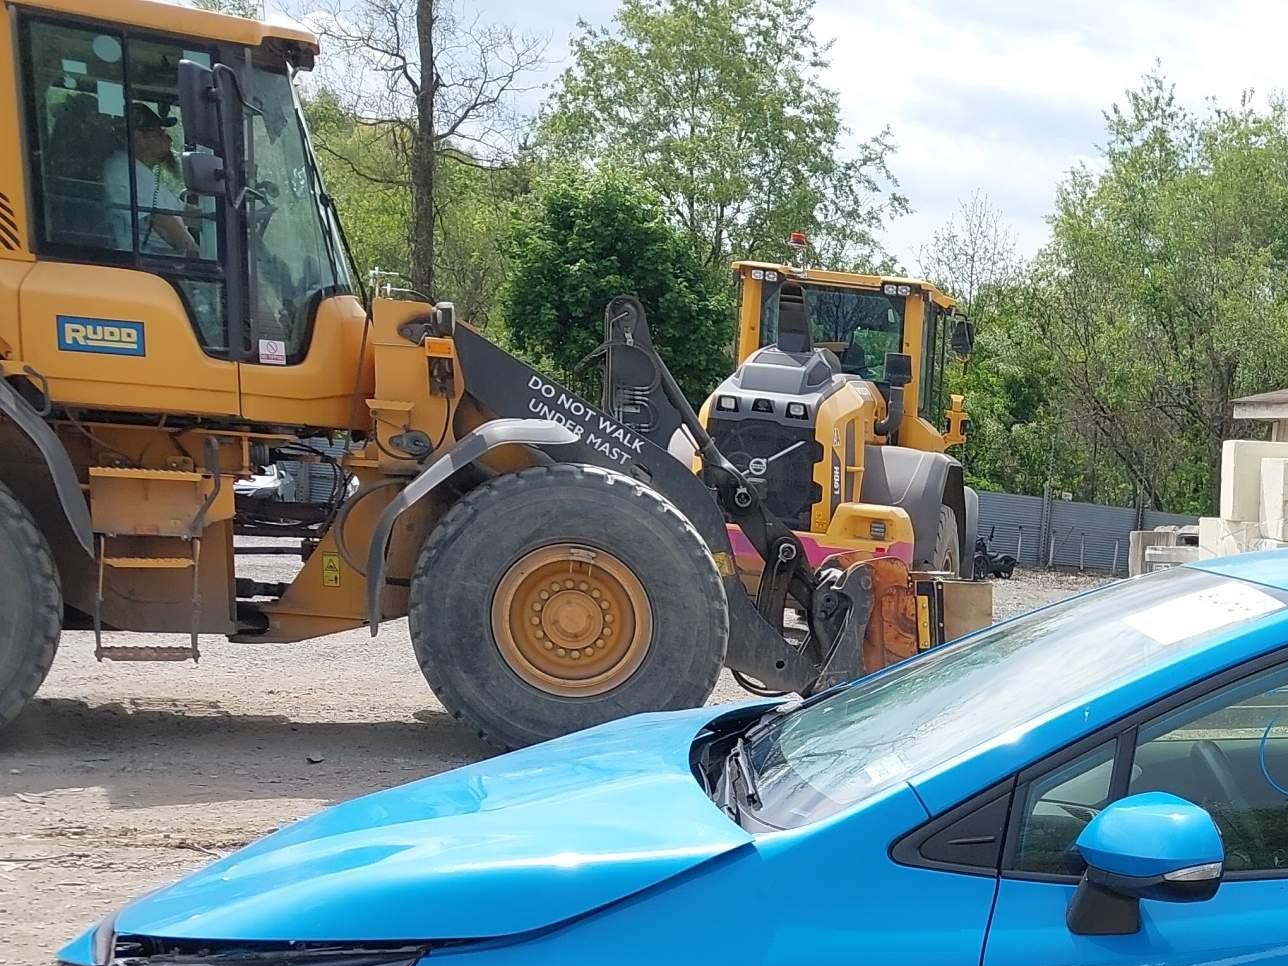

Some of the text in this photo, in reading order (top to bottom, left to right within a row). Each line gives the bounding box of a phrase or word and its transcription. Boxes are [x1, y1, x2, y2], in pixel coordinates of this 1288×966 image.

[64, 323, 138, 346] RUDD
[528, 375, 645, 453] DO NOT WALK
[586, 433, 632, 465] MAST
